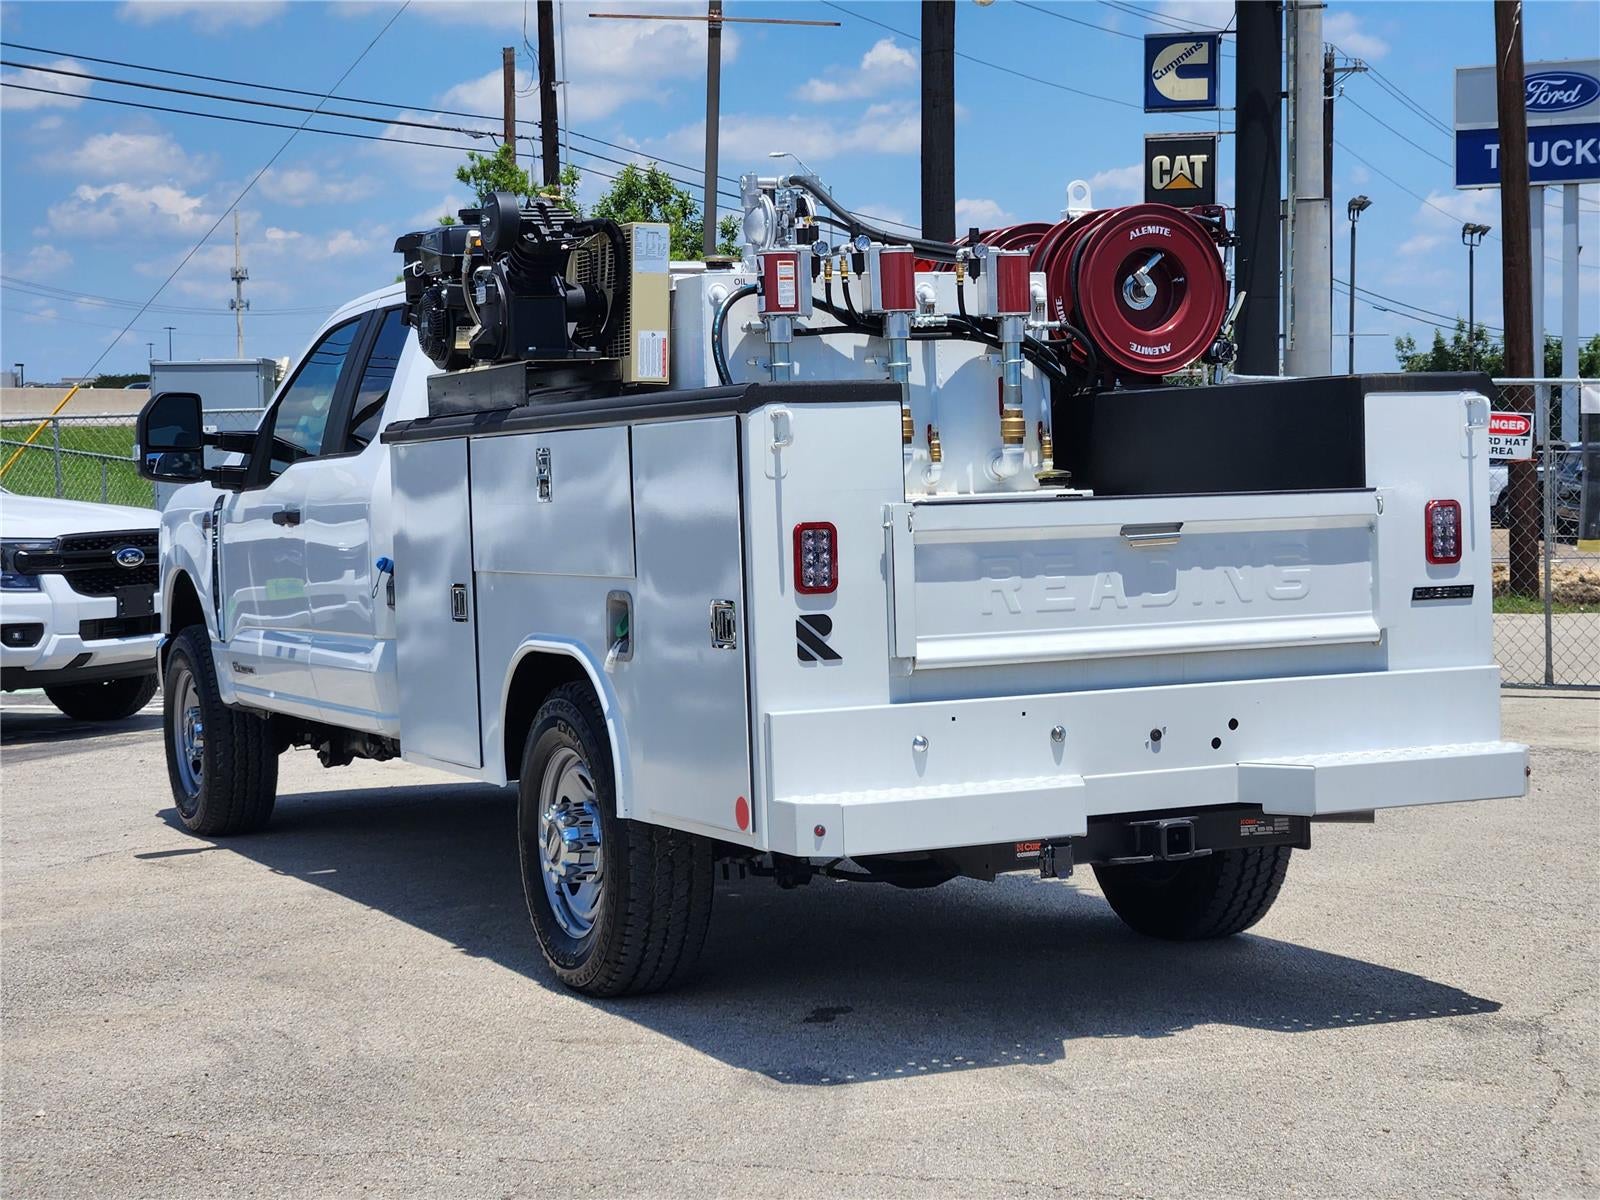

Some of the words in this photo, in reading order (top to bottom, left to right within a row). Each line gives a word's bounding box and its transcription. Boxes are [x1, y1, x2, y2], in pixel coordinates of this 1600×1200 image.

[1153, 42, 1203, 80] Cummins
[1526, 79, 1582, 106] Ford
[1484, 138, 1600, 169] TUCK
[1152, 155, 1207, 190] CAT
[1130, 225, 1171, 240] ALEMITE
[734, 278, 748, 286] OIL
[1129, 342, 1171, 355] ALEMITE
[1491, 419, 1526, 430] NGER
[1505, 438, 1529, 446] HAT
[1489, 446, 1514, 455] REA
[981, 543, 1312, 615] READING
